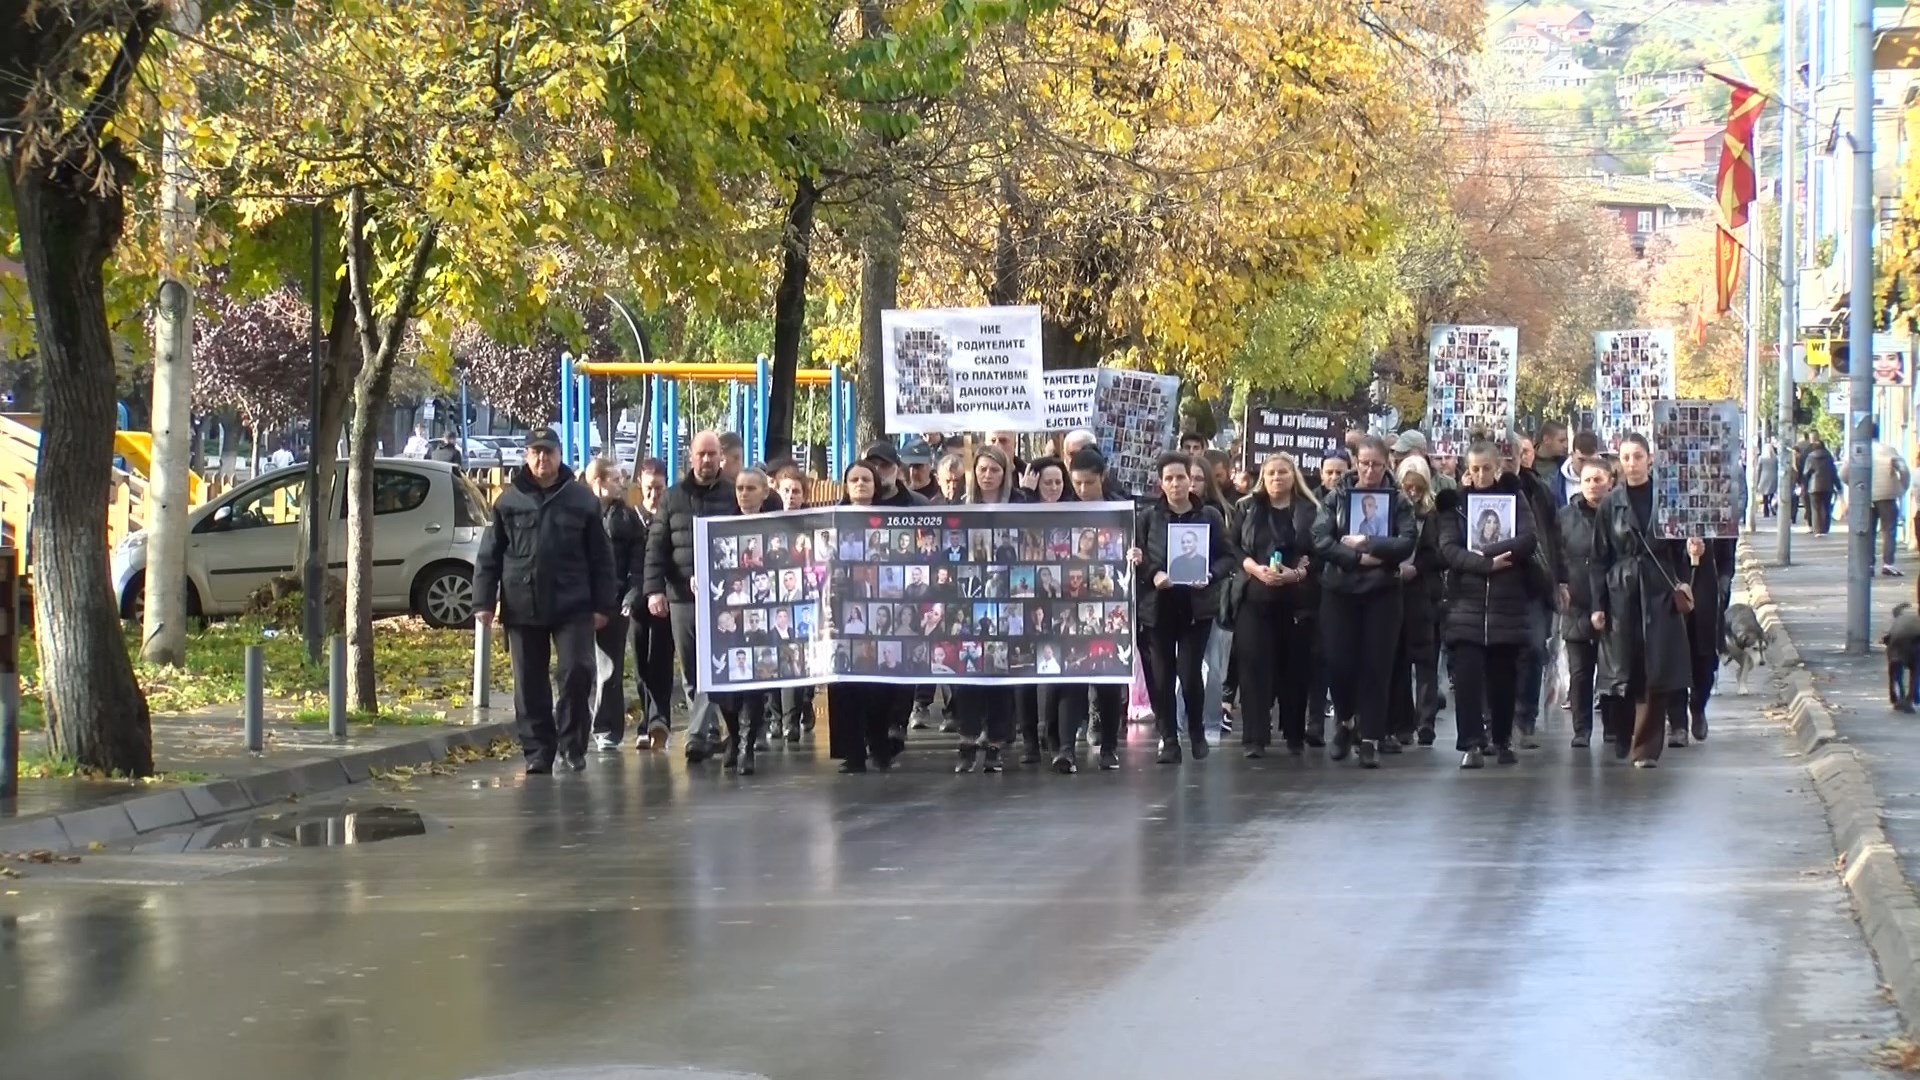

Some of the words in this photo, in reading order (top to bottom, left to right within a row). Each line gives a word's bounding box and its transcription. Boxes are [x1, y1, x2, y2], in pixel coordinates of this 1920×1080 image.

[980, 325, 1001, 334] НИЕ
[957, 339, 1025, 351] РОДИТЕЛИТЕ
[974, 355, 1009, 365] СКАПО
[956, 371, 969, 381] ГО
[972, 369, 1028, 381] ПЛАТИВМЕ
[1043, 375, 1080, 386] ТАНЕТЕ
[1082, 373, 1096, 385] ДА
[959, 386, 1009, 398] ДАНОКОТ
[1012, 385, 1026, 395] НА
[1043, 389, 1055, 400] ТЕ
[1058, 387, 1094, 399] ТОРТУР
[956, 401, 1031, 412] КОРУПЦИЈАТА
[1048, 402, 1088, 414] НАШИТЕ
[1046, 417, 1082, 428] ЕЈСТВА
[1282, 413, 1328, 430] изгубивме
[1273, 433, 1294, 448] уште
[1297, 435, 1324, 450] имате
[1327, 437, 1337, 450] за
[886, 516, 943, 526] 16.03.2025
